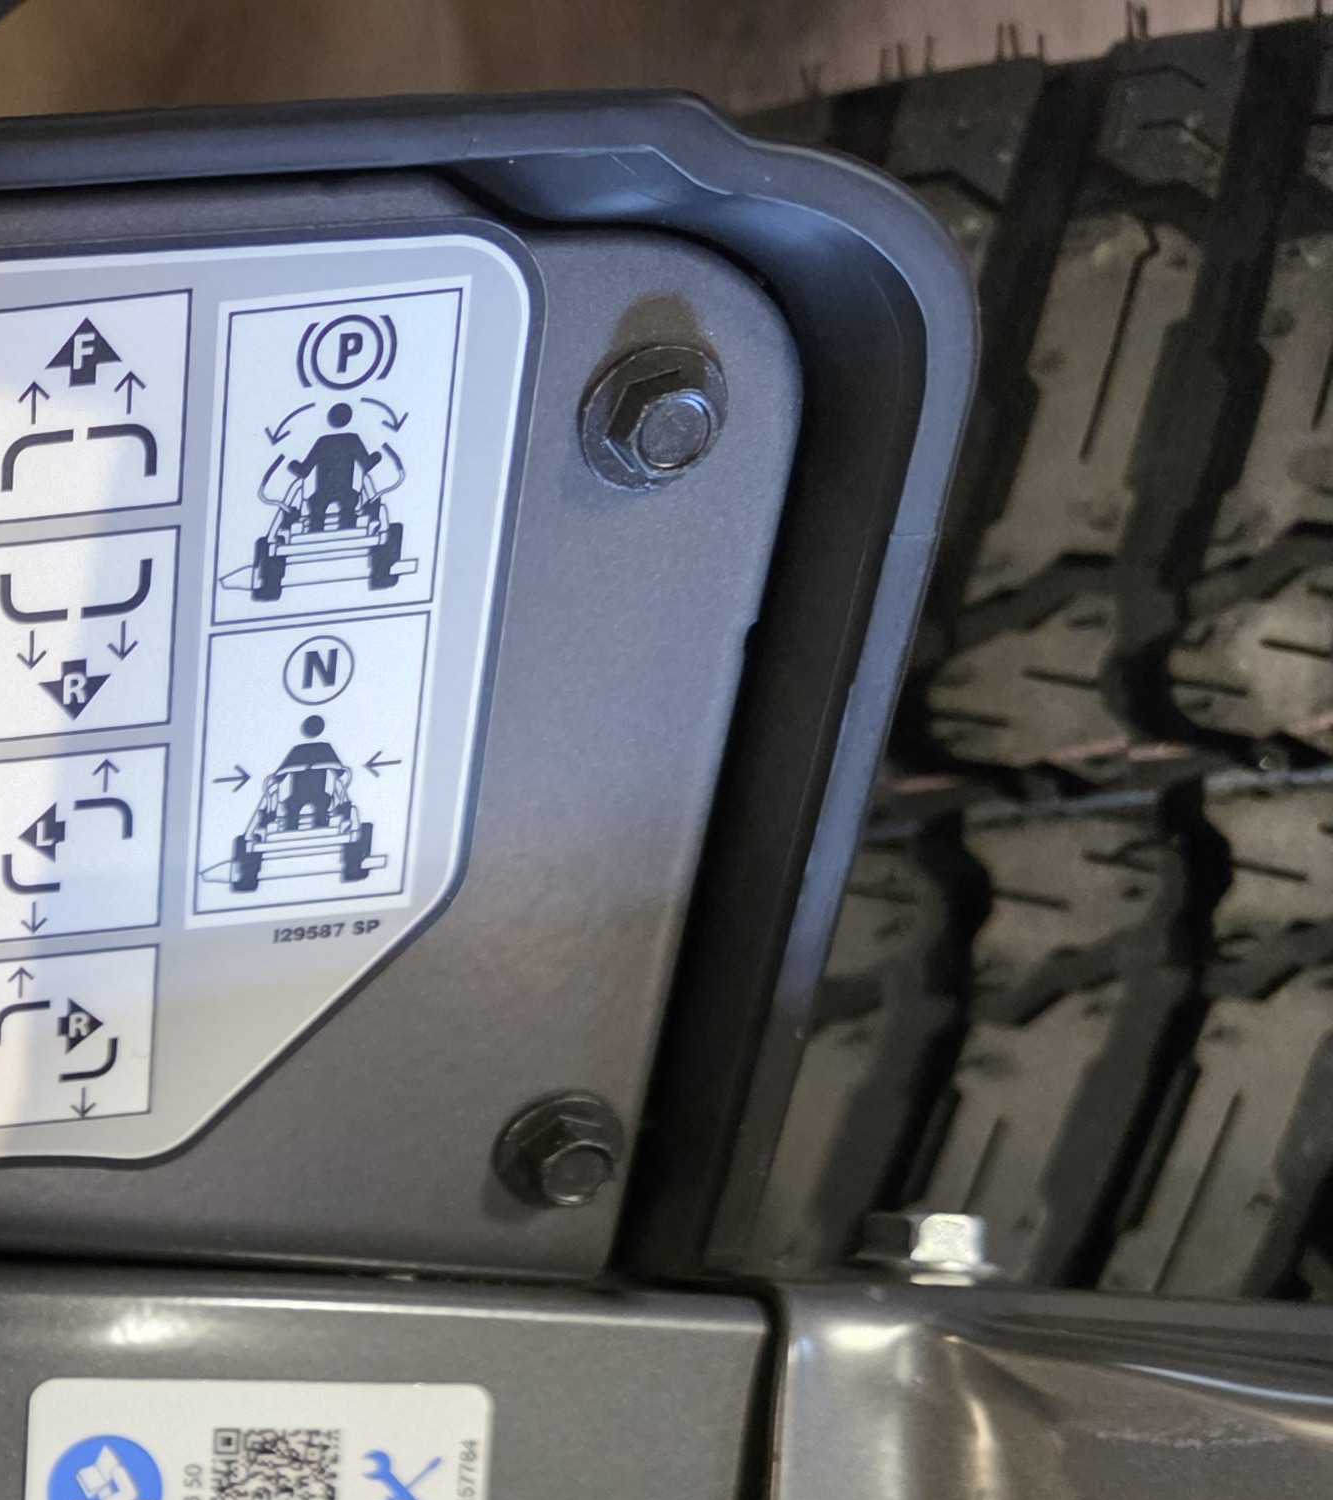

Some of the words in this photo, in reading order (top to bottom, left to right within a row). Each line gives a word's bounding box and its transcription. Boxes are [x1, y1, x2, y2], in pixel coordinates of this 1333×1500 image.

[73, 332, 95, 370] F
[336, 332, 364, 374] P
[302, 649, 340, 690] N
[63, 673, 88, 706] R
[36, 818, 56, 847] L
[272, 922, 345, 944] 129587
[352, 919, 381, 936] SP
[67, 1012, 92, 1040] R
